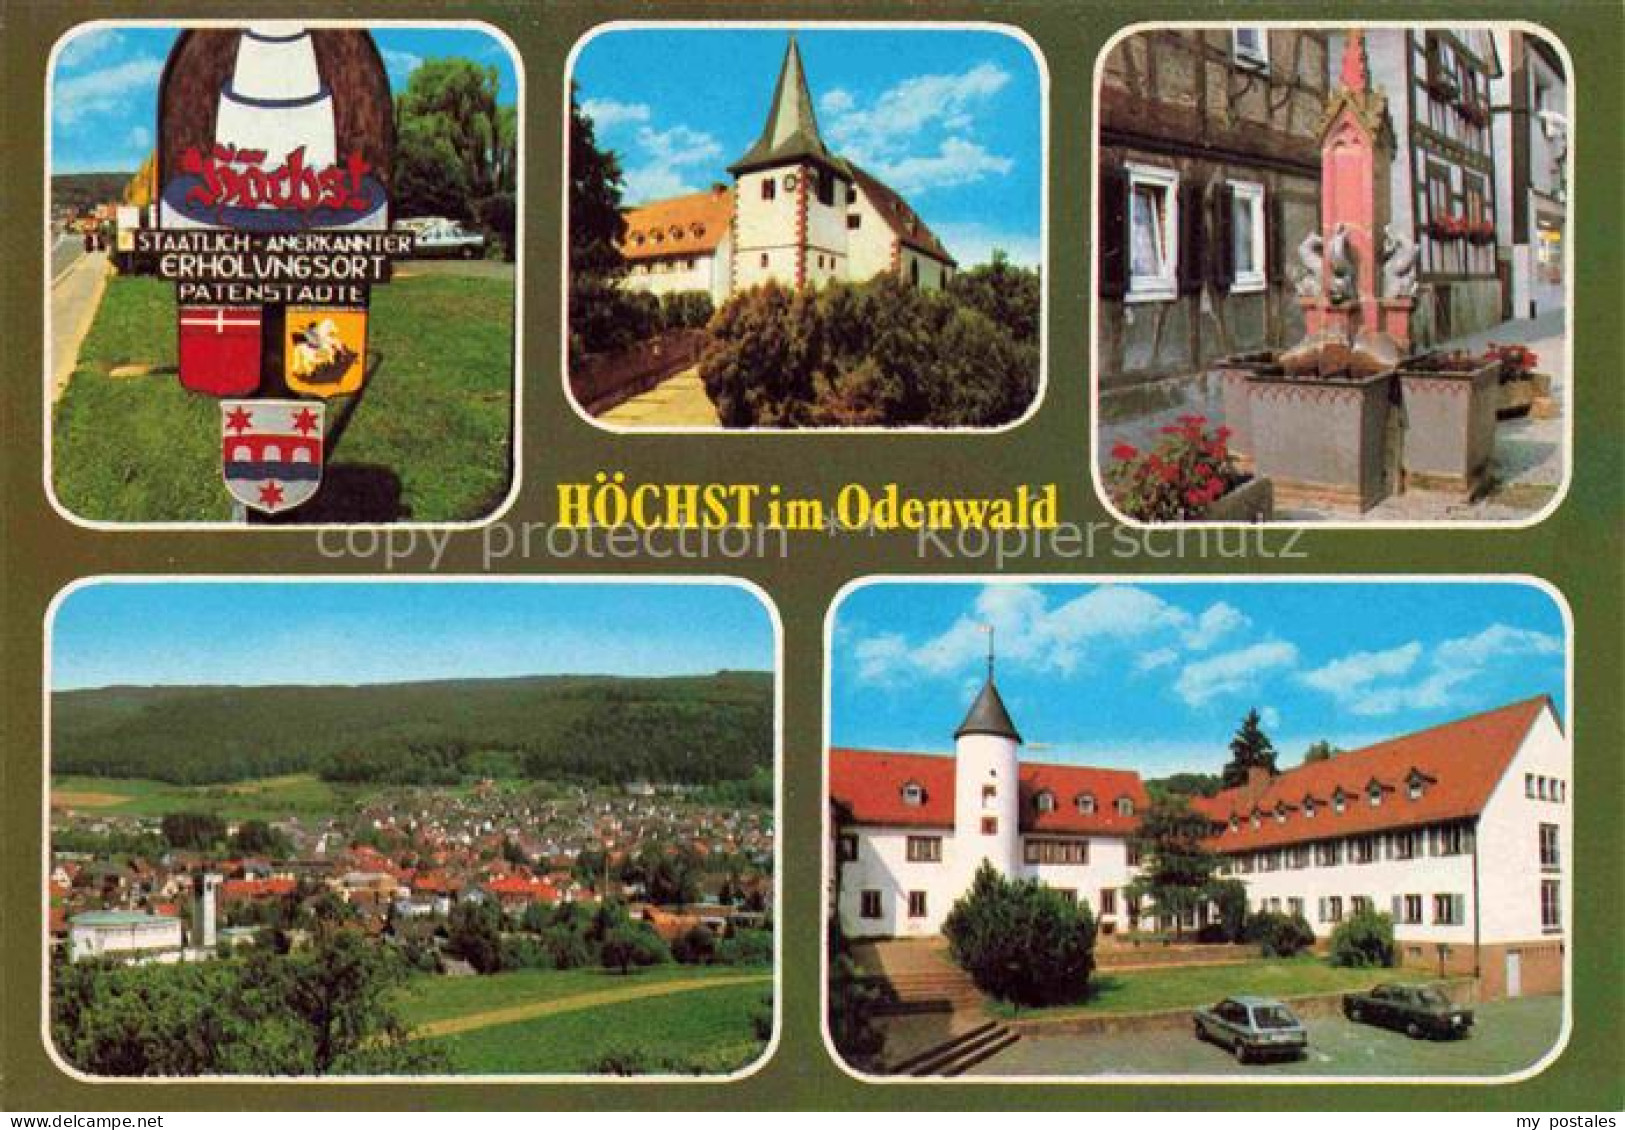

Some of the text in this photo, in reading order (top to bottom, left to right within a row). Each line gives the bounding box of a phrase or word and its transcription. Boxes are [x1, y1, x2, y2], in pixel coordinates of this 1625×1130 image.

[557, 472, 1057, 530] HÖCHST im Odenwald
